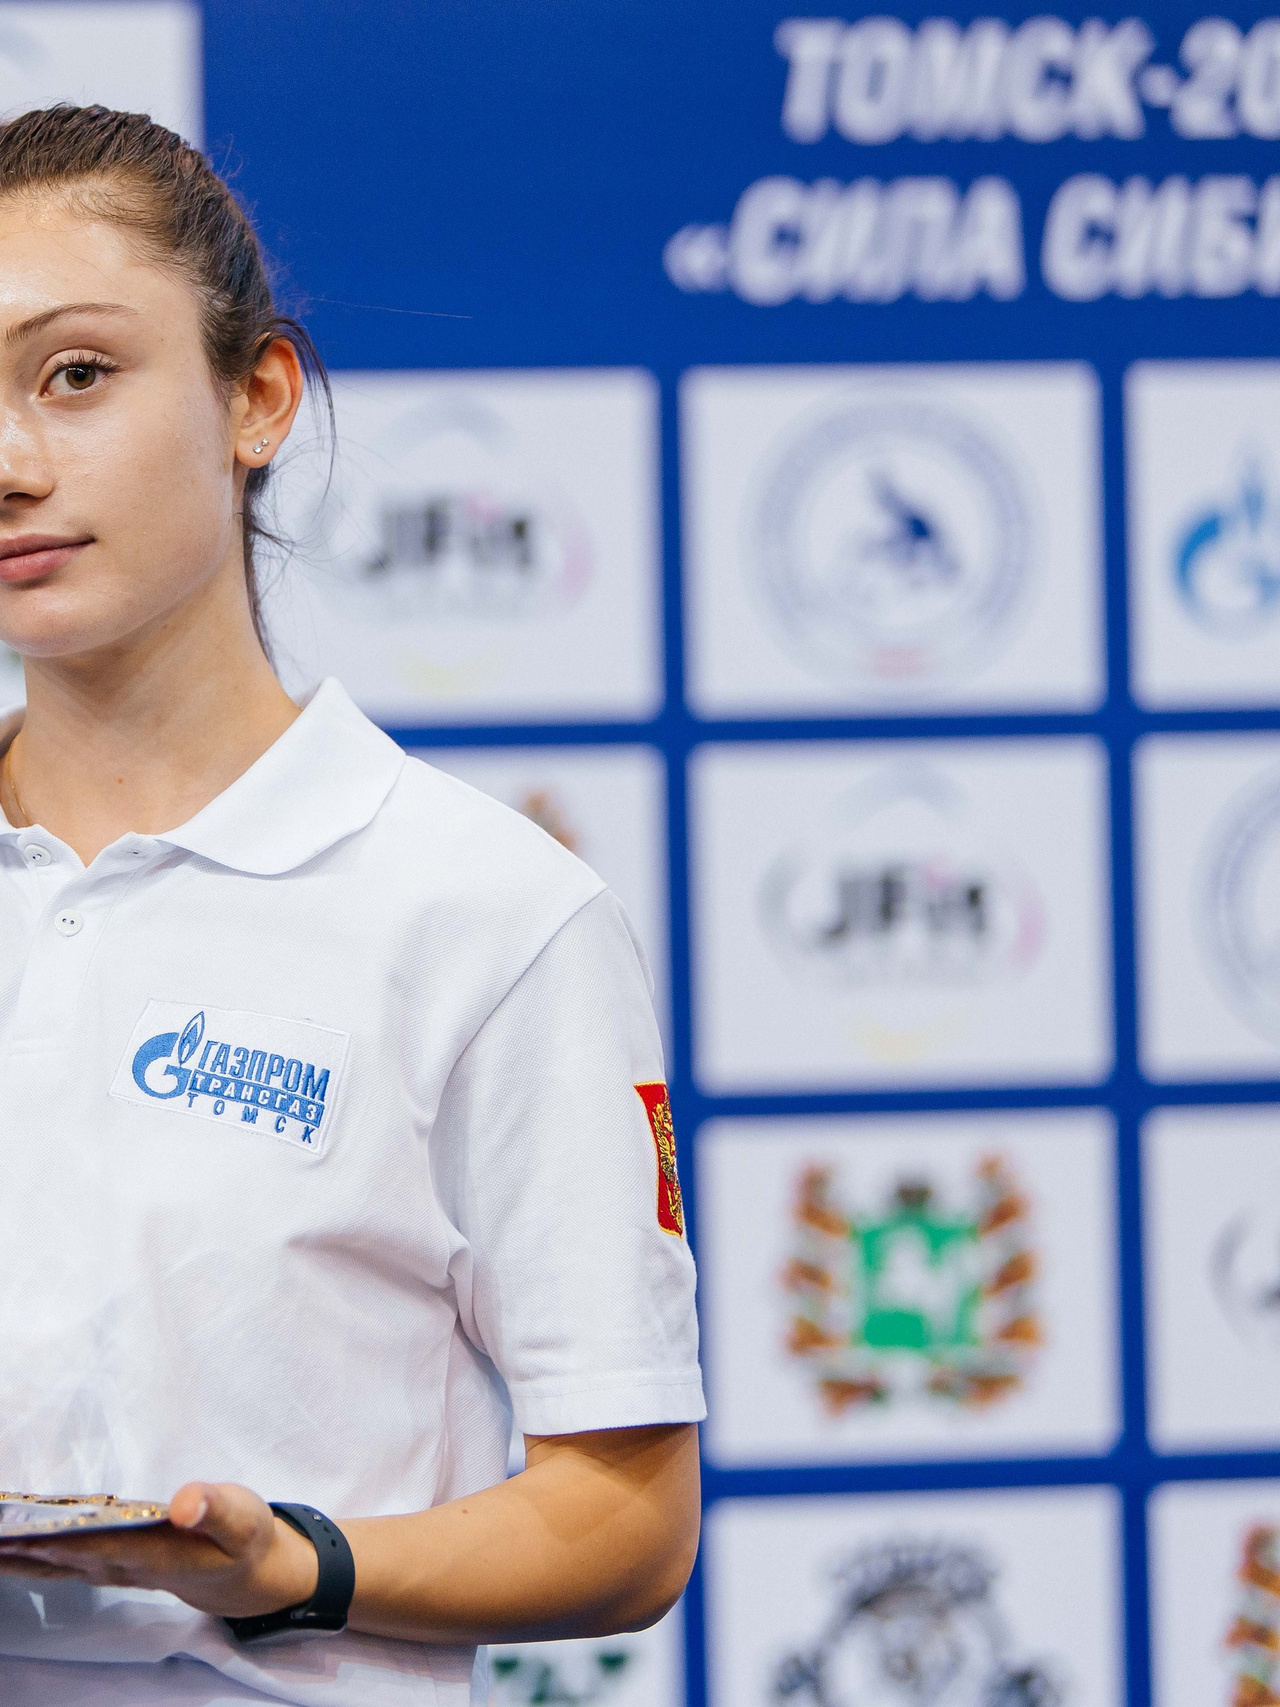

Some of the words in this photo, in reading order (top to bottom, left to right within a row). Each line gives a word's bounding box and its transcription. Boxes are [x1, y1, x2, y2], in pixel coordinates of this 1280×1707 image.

[664, 176, 1026, 304] «СИЛА
[193, 1073, 320, 1122] ТРАНСГАЗ
[197, 1040, 330, 1102] ГАЗПРОМ
[186, 1092, 315, 1144] ТОМСК
